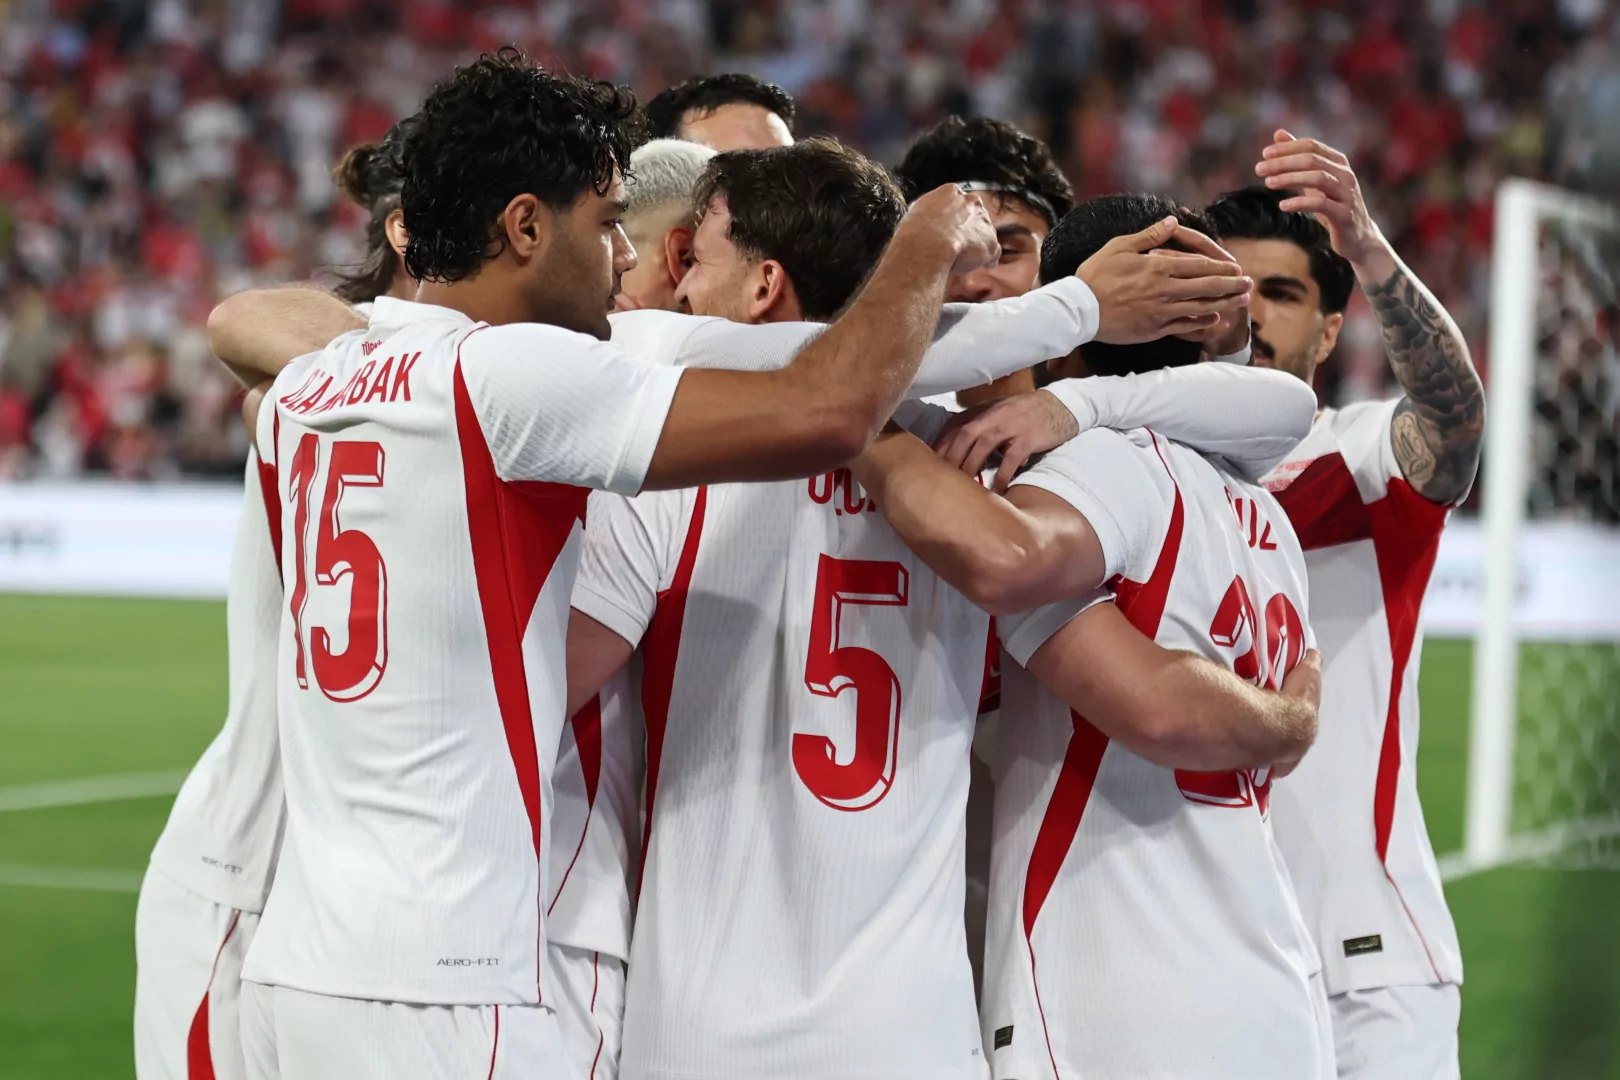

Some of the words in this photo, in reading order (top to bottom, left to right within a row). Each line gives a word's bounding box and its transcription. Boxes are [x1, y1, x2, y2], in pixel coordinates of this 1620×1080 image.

[290, 433, 388, 703] 15
[792, 553, 909, 812] 5
[437, 957, 499, 967] AERO-FIT
